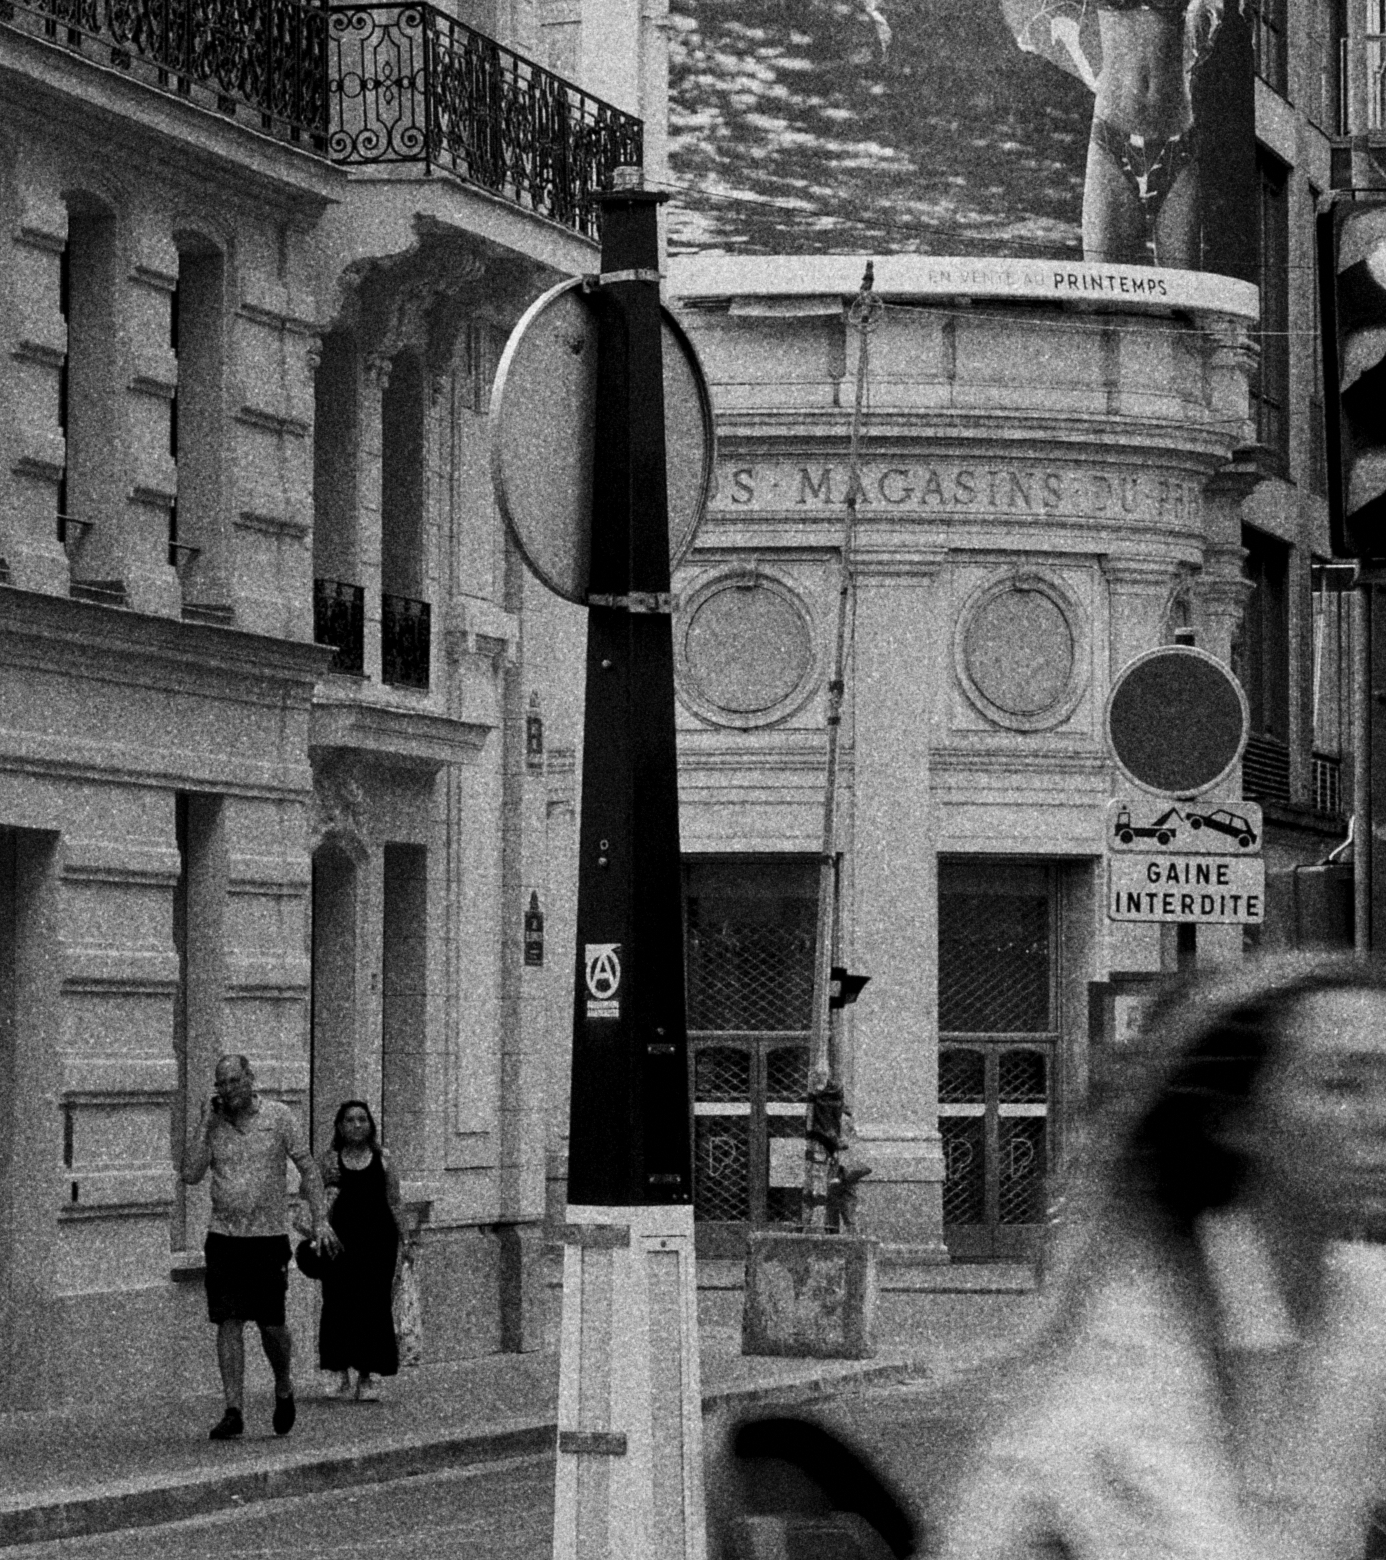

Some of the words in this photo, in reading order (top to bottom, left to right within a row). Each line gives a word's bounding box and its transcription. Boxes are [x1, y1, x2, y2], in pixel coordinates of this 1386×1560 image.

[1053, 272, 1167, 296] PRINTEMPS
[795, 467, 1064, 511] MAGASINS
[1147, 862, 1230, 886] GAINE
[1115, 891, 1260, 917] INTERDITE
